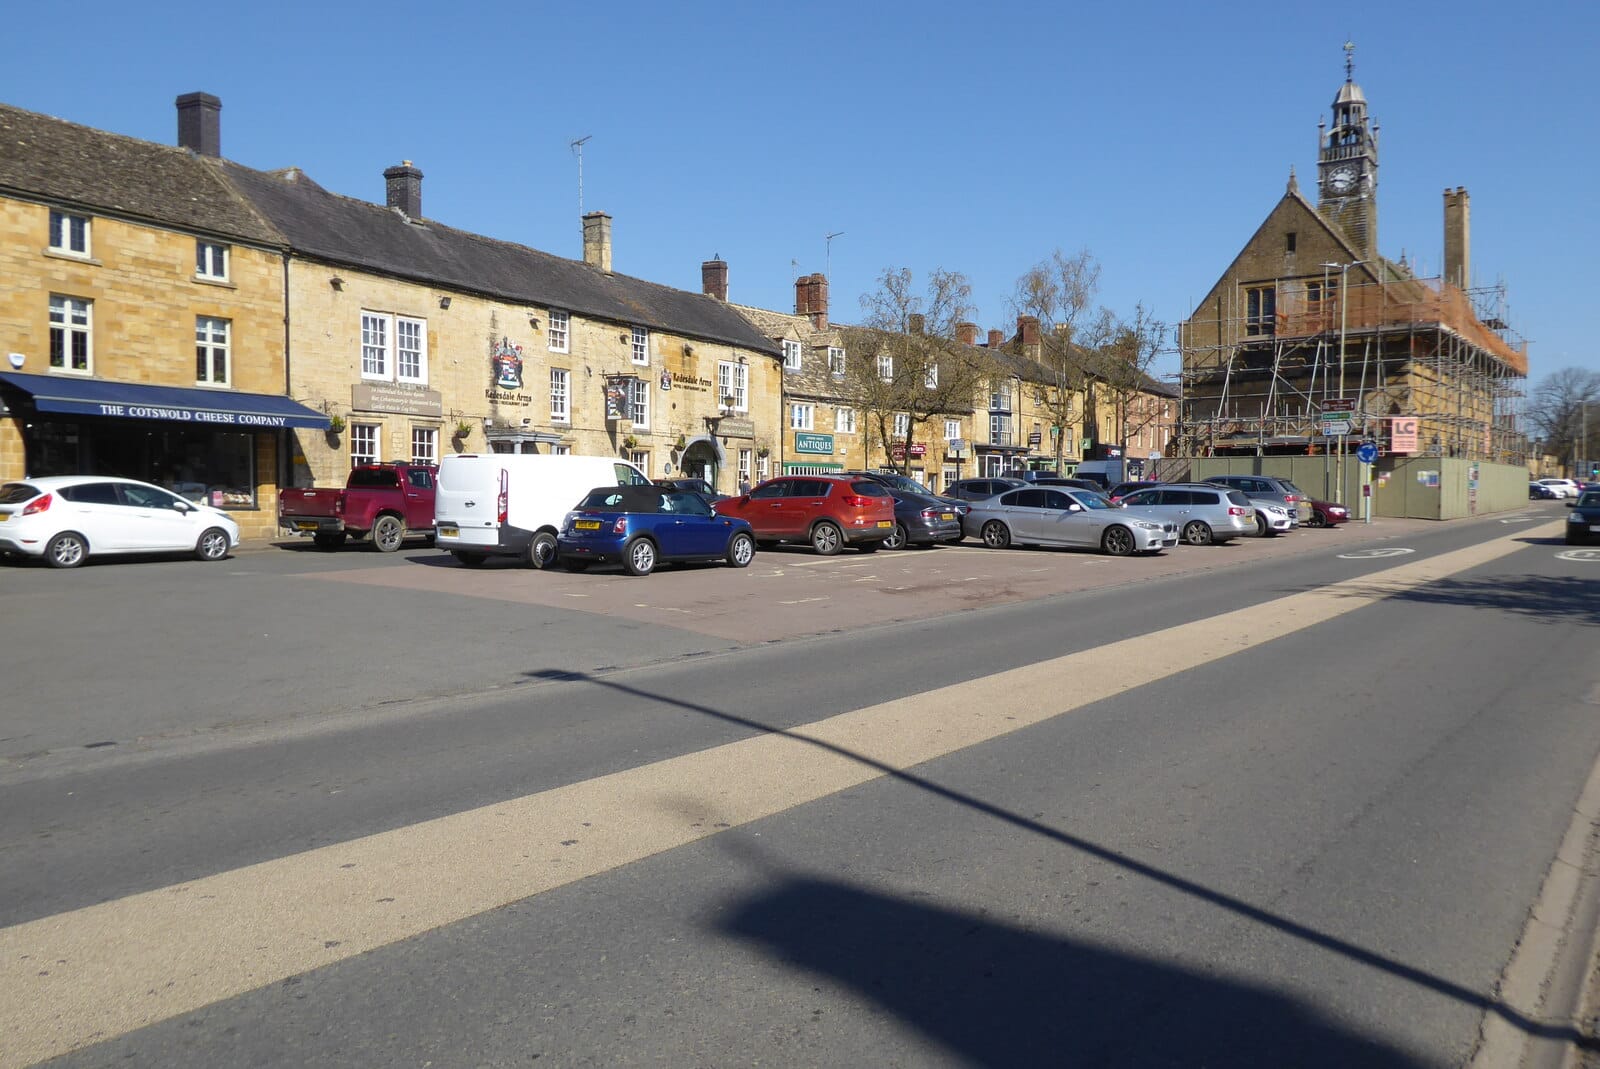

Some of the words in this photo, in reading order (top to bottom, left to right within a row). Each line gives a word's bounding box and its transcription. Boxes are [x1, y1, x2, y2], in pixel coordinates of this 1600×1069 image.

[516, 393, 532, 402] Arms
[100, 404, 124, 416] THE
[129, 406, 191, 421] COTSWOLD
[195, 411, 235, 424] CHEESE
[239, 414, 286, 426] COMPANY
[1394, 422, 1415, 434] LC
[798, 440, 832, 451] ANTIQUES
